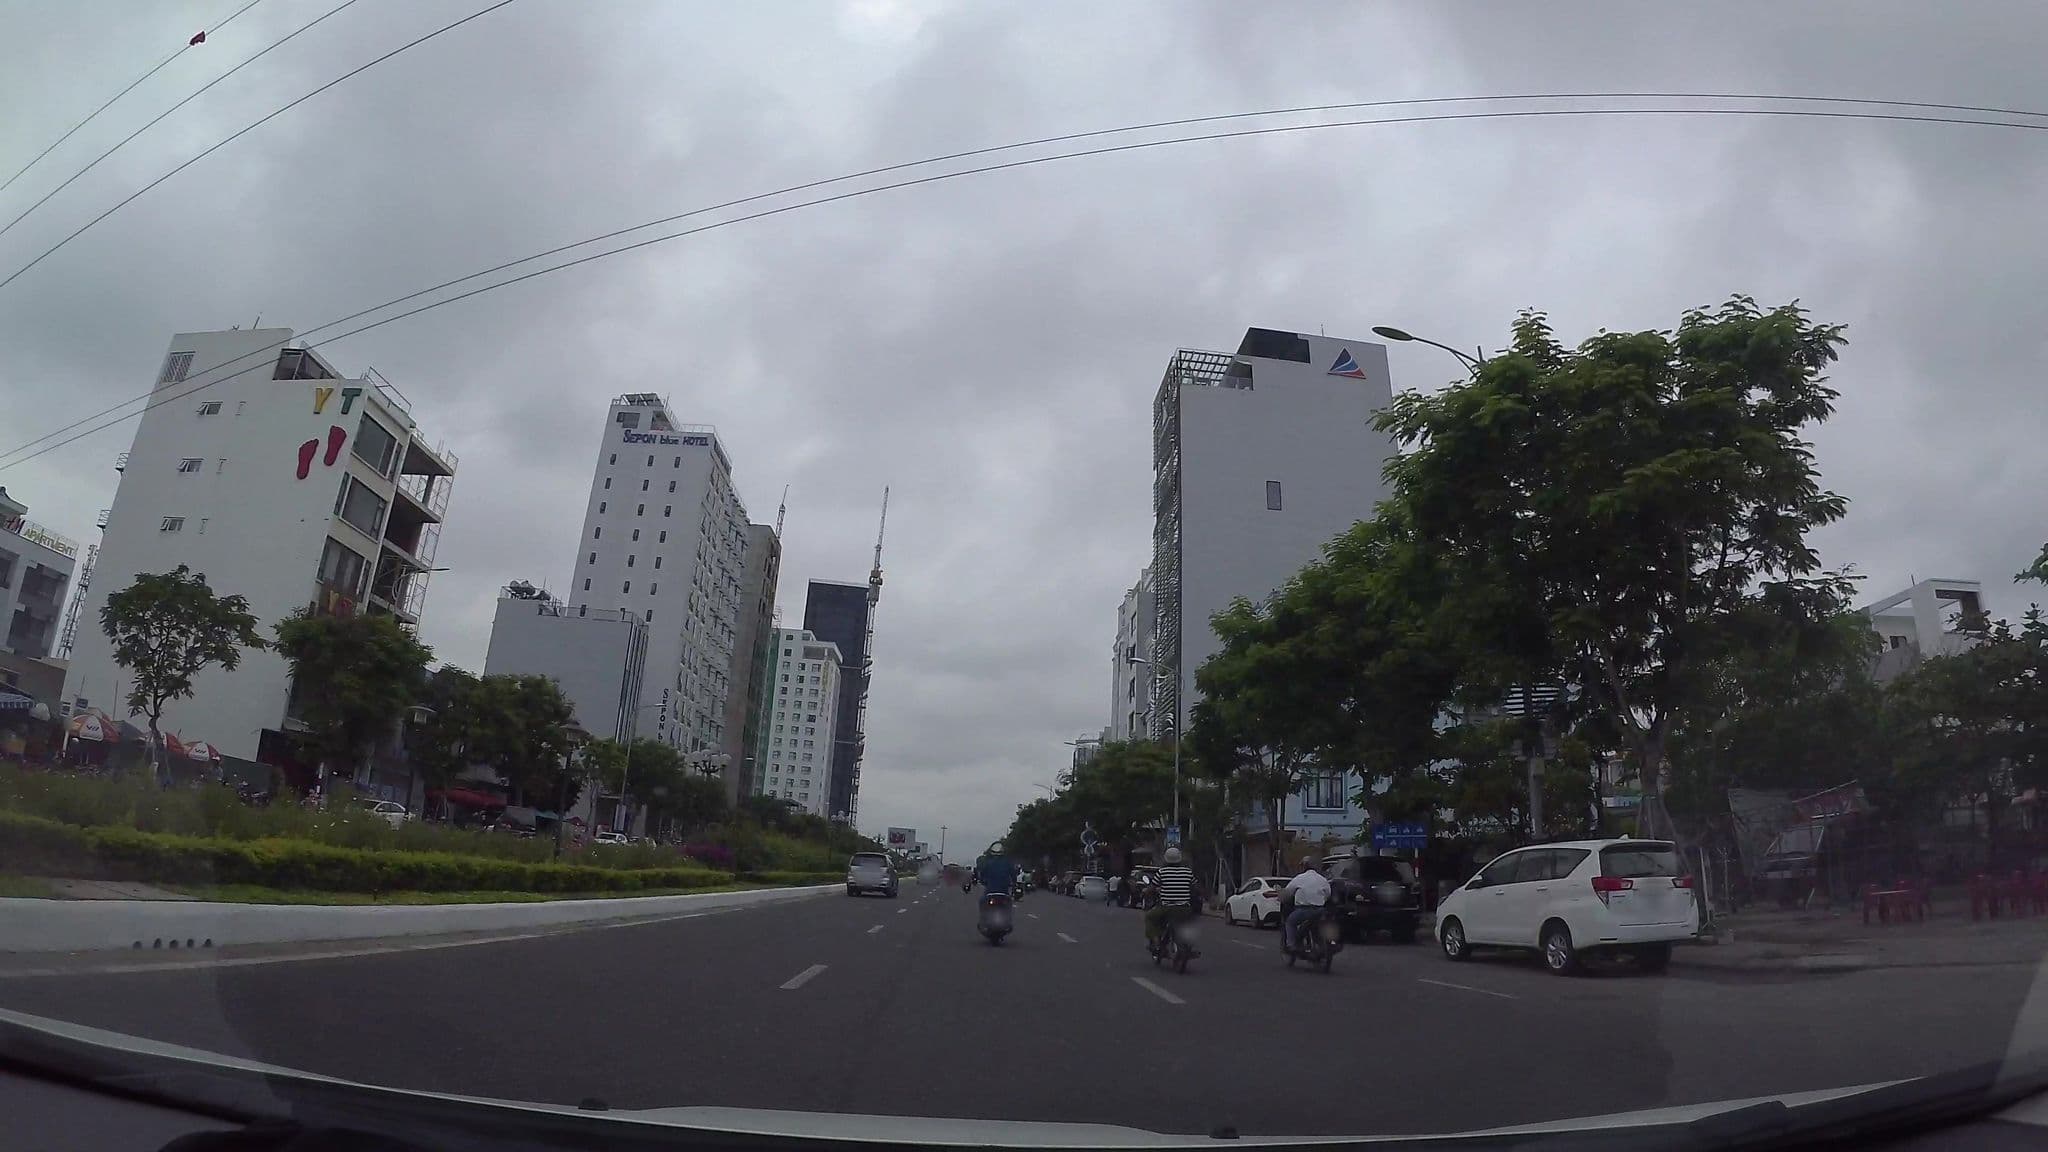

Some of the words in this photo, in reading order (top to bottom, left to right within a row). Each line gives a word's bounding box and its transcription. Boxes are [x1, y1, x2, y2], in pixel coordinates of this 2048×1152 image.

[313, 387, 362, 415] YT
[623, 429, 657, 444] SEPON
[660, 434, 679, 445] blue
[682, 436, 709, 447] HOTEL
